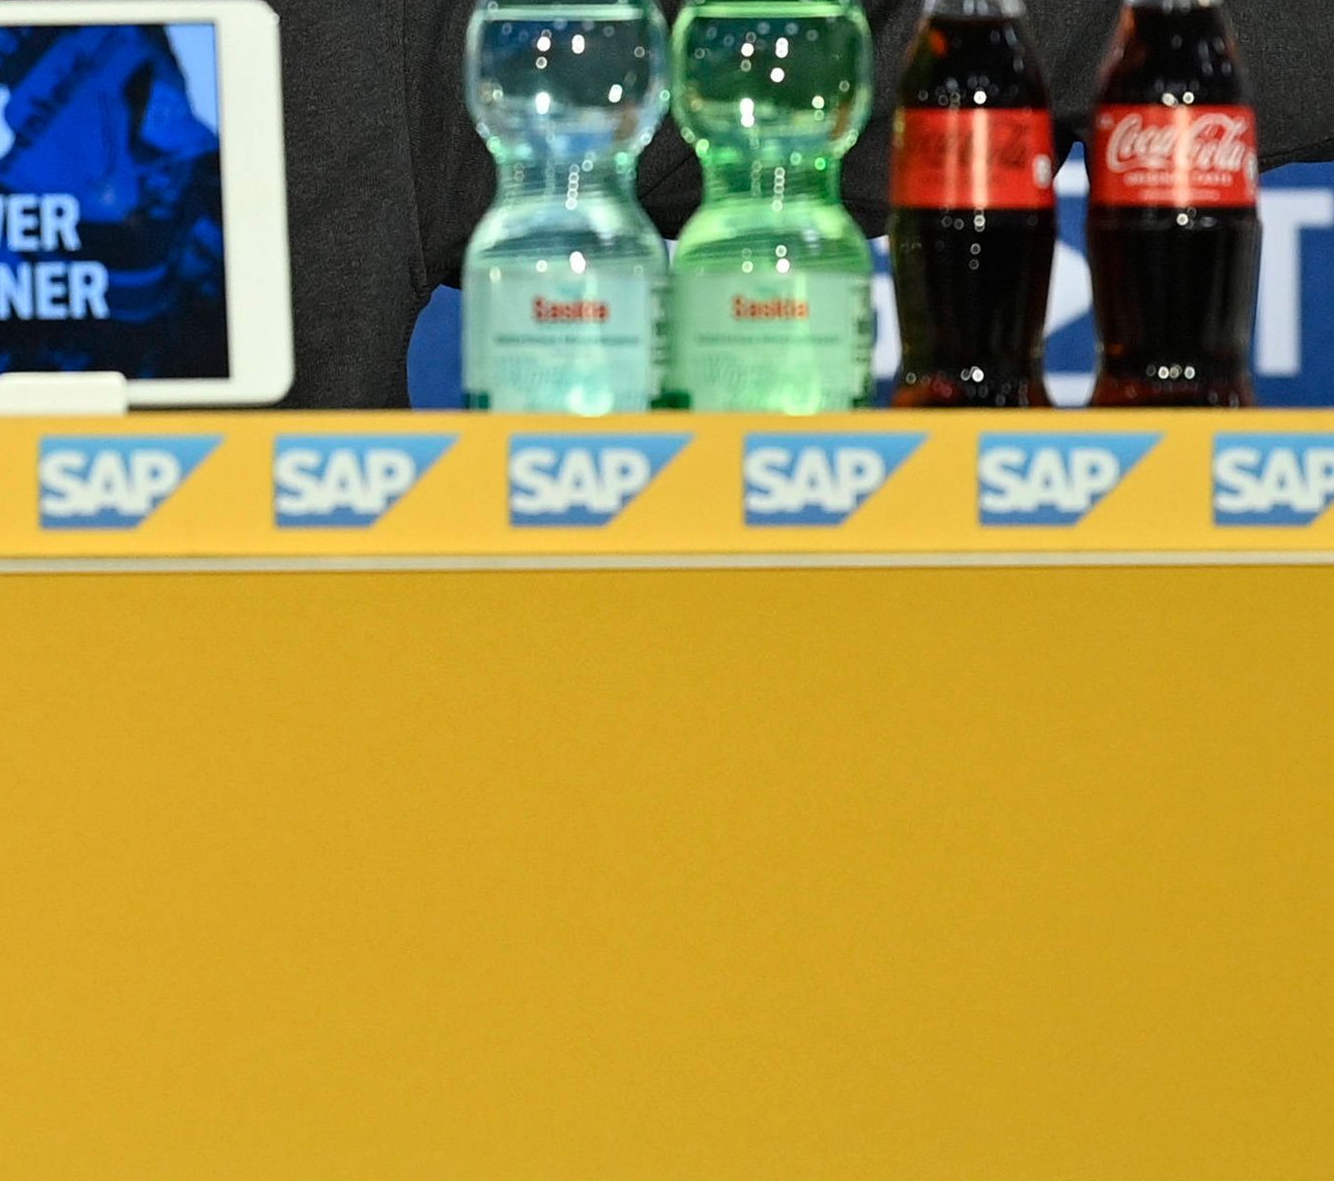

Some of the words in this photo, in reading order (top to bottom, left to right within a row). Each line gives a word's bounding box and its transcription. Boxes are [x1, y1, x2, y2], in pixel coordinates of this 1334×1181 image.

[40, 450, 181, 517] SAP
[275, 448, 415, 515] SAP
[510, 448, 649, 514] SAP
[745, 447, 885, 513] SAP
[979, 447, 1118, 513] SAP
